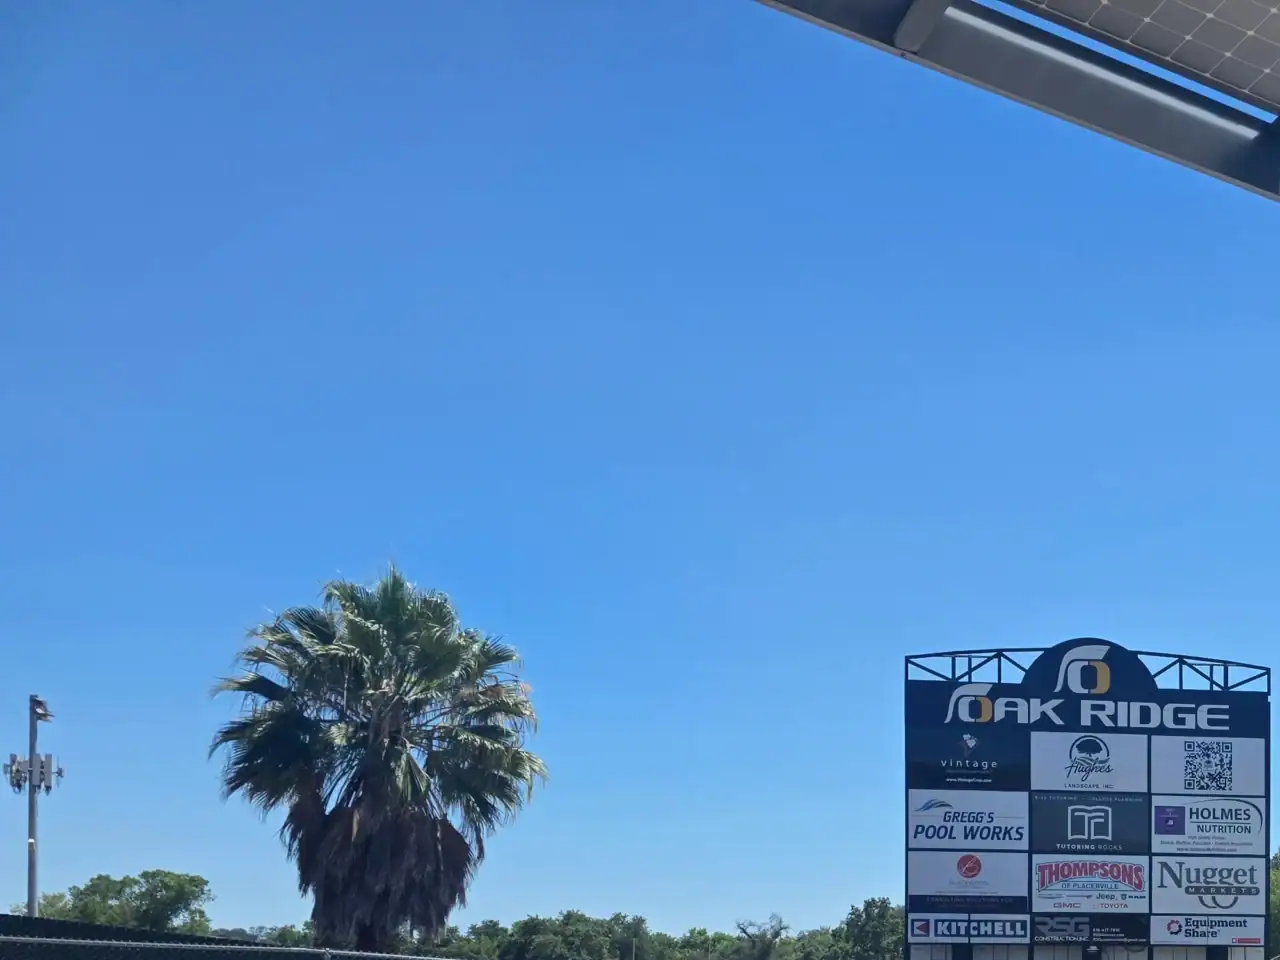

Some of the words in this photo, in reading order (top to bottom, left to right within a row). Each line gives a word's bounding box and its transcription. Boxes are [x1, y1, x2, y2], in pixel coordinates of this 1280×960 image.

[944, 684, 1064, 724] OAK
[1081, 700, 1230, 730] RIDGE
[941, 759, 997, 769] vintage
[1064, 756, 1114, 782] Hughes
[943, 811, 994, 823] GREGG'S
[1189, 807, 1251, 821] HOLMES
[913, 824, 957, 840] POOL
[963, 825, 1025, 841] WORKS
[1196, 824, 1251, 834] NUTRITION
[1037, 861, 1145, 892] THOMPSONS
[1157, 861, 1258, 888] Nugget
[1073, 882, 1119, 890] PLACERVILLE
[1096, 892, 1115, 900] Jeep
[936, 921, 1025, 936] KITCHELL
[1034, 917, 1090, 937] RSG
[1184, 917, 1248, 929] Equipment
[1184, 928, 1219, 938] Share
